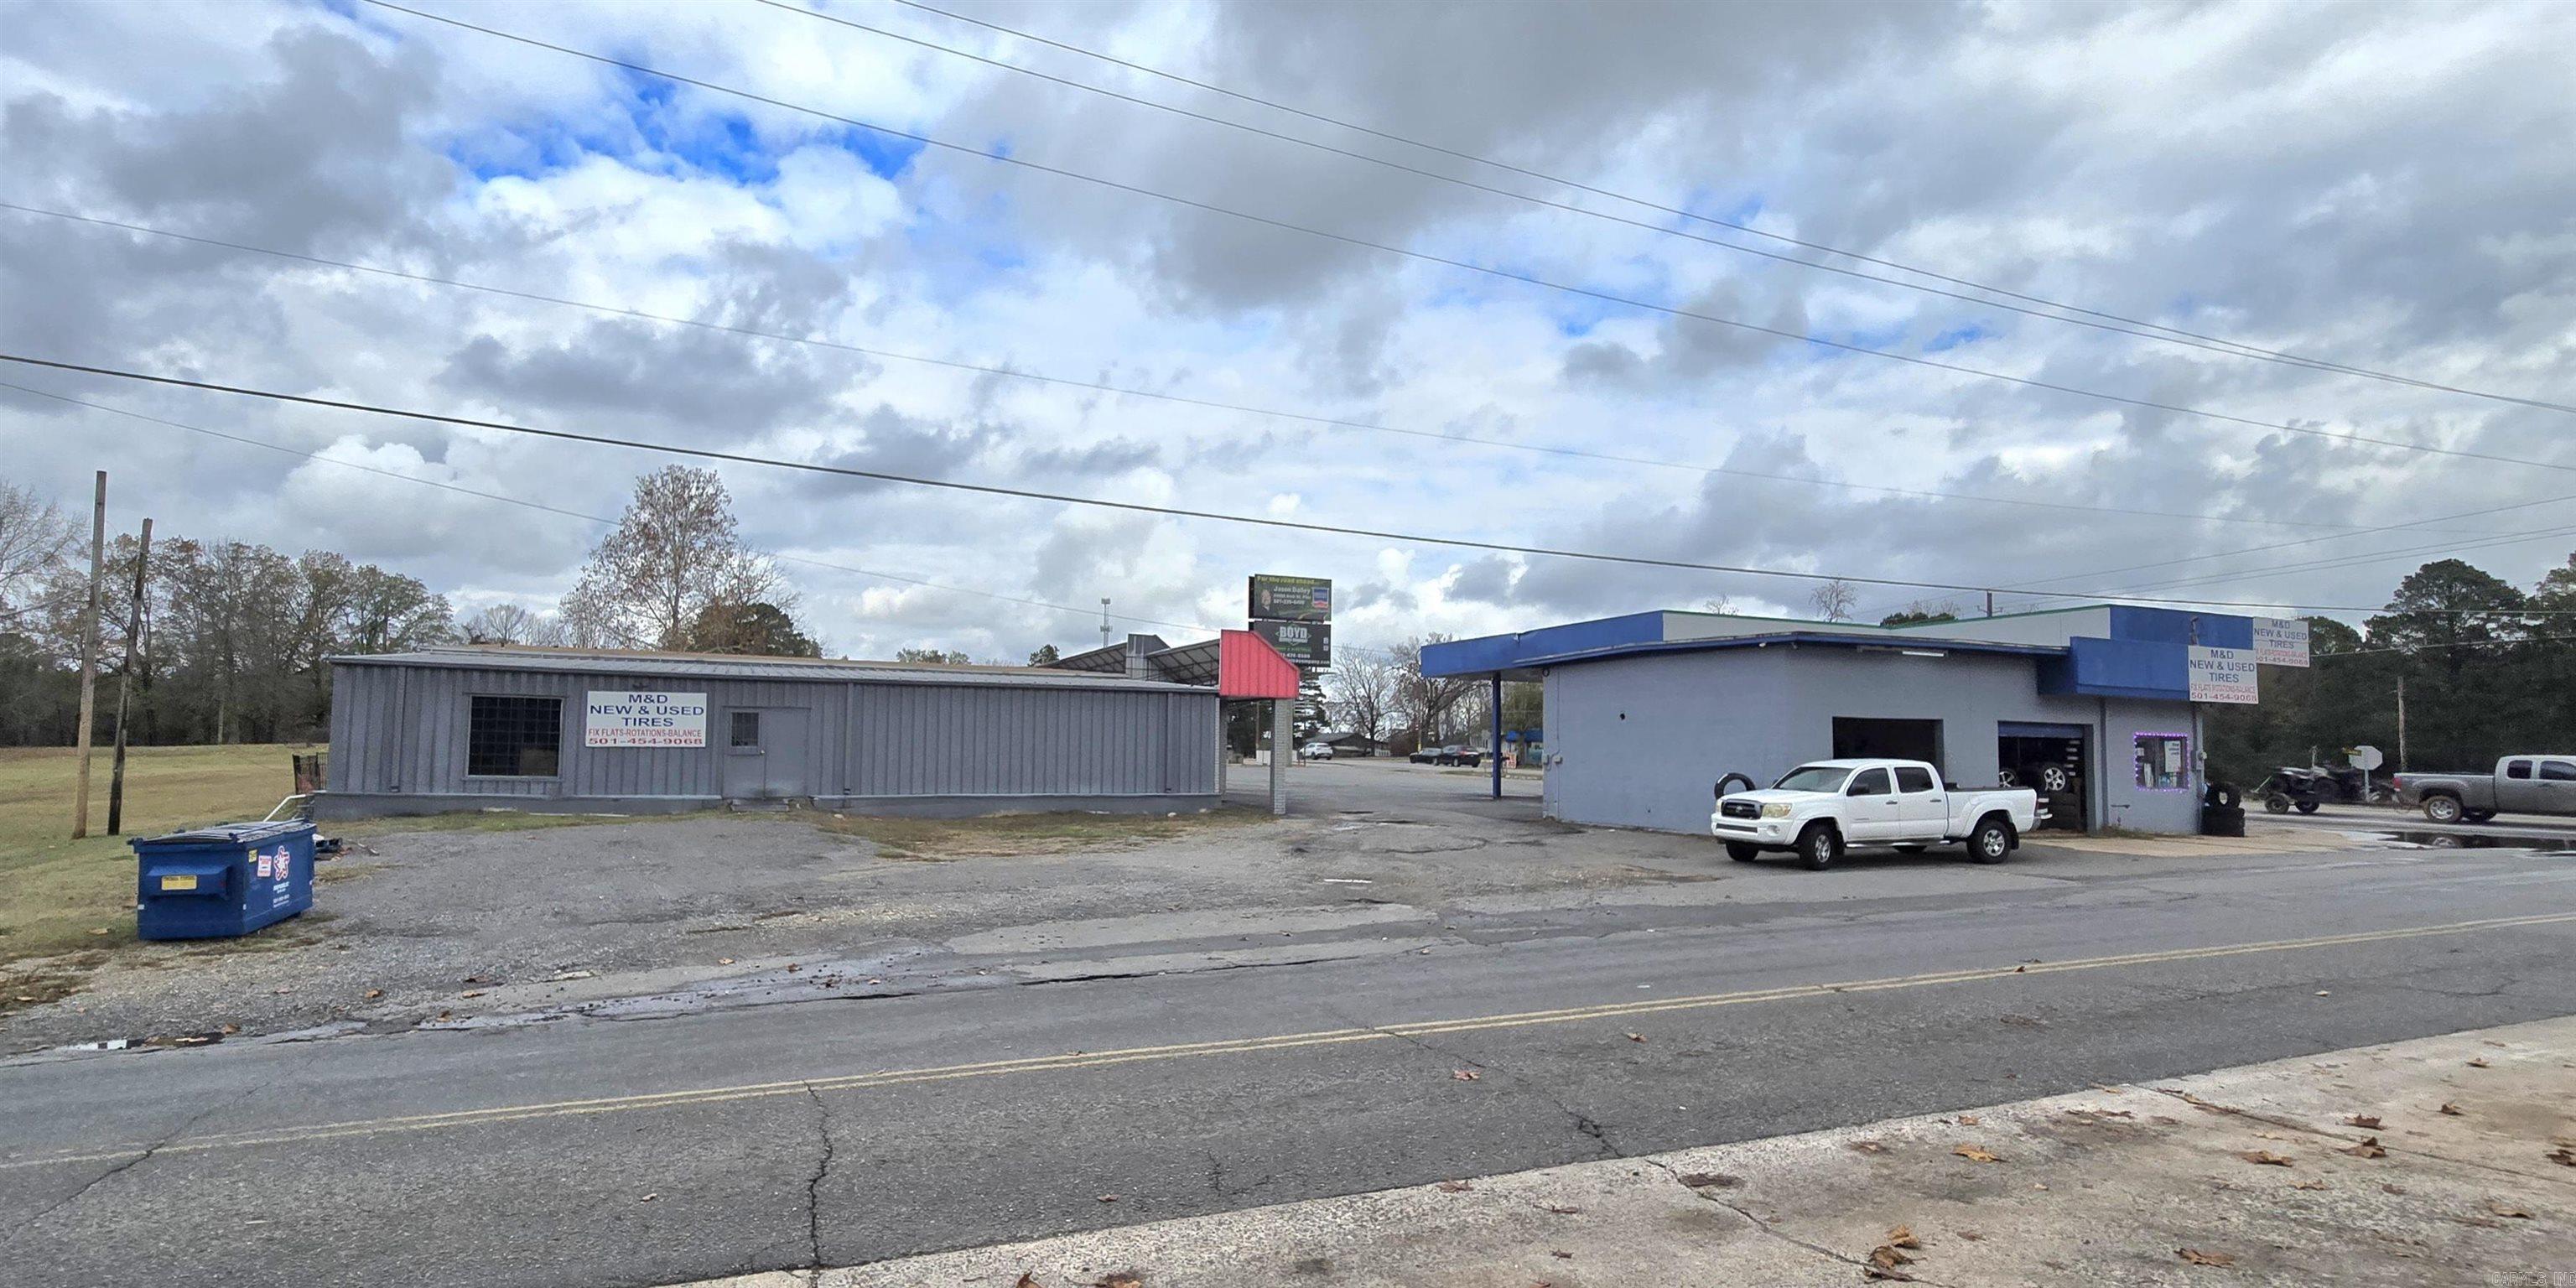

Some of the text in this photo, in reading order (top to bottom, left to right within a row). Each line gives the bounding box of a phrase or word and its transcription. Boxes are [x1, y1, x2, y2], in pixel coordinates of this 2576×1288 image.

[2272, 619, 2291, 629] M&D
[1280, 626, 1307, 638] BOYD
[2254, 628, 2308, 641] NEW & USED
[2268, 639, 2294, 649] TIRES
[2210, 649, 2234, 659] M&D
[2189, 659, 2256, 672] NEW & USED
[2209, 672, 2240, 683] TIRES
[628, 694, 668, 704] M&D
[589, 705, 704, 716] NEW & USED
[621, 717, 674, 727] TIRES
[588, 728, 600, 737] FIX
